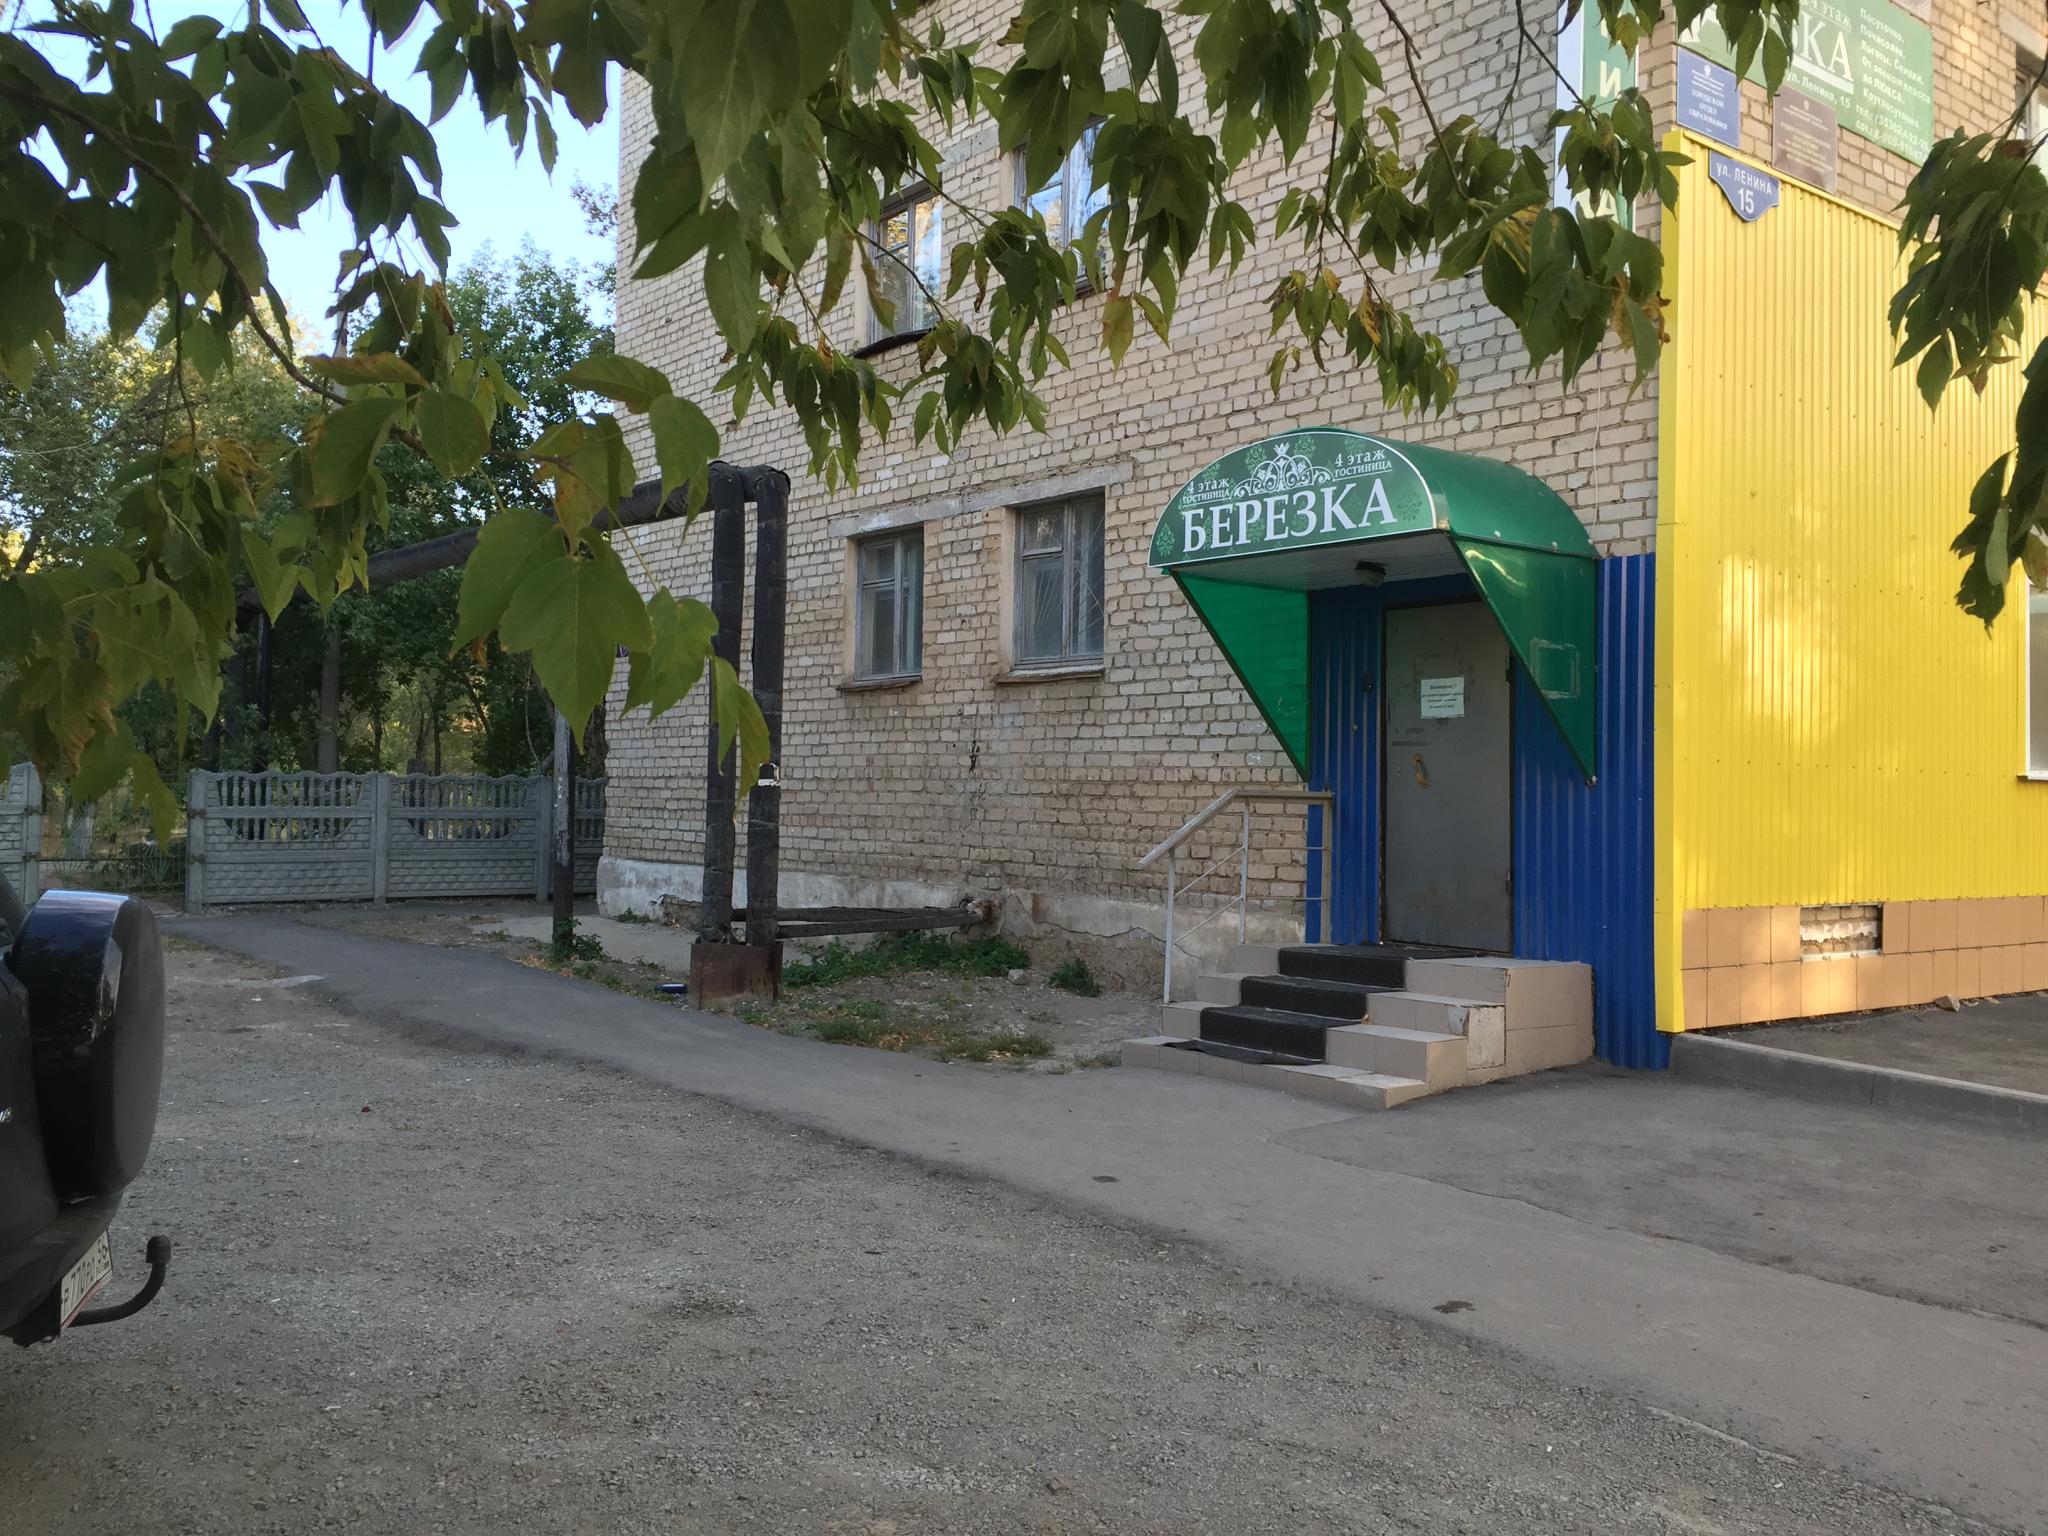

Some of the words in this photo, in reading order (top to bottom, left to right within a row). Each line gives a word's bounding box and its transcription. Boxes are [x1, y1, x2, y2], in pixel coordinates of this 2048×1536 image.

[1840, 95, 1851, 109] 15
[1716, 162, 1732, 179] ул.
[1734, 168, 1773, 196] ЛЕНИНА
[1738, 187, 1755, 214] 15
[1335, 453, 1343, 468] 4
[1347, 449, 1386, 466] этаж
[1187, 481, 1195, 494] 4
[1198, 478, 1230, 493] этаж
[1182, 478, 1397, 553] БЕРЕЗКА
